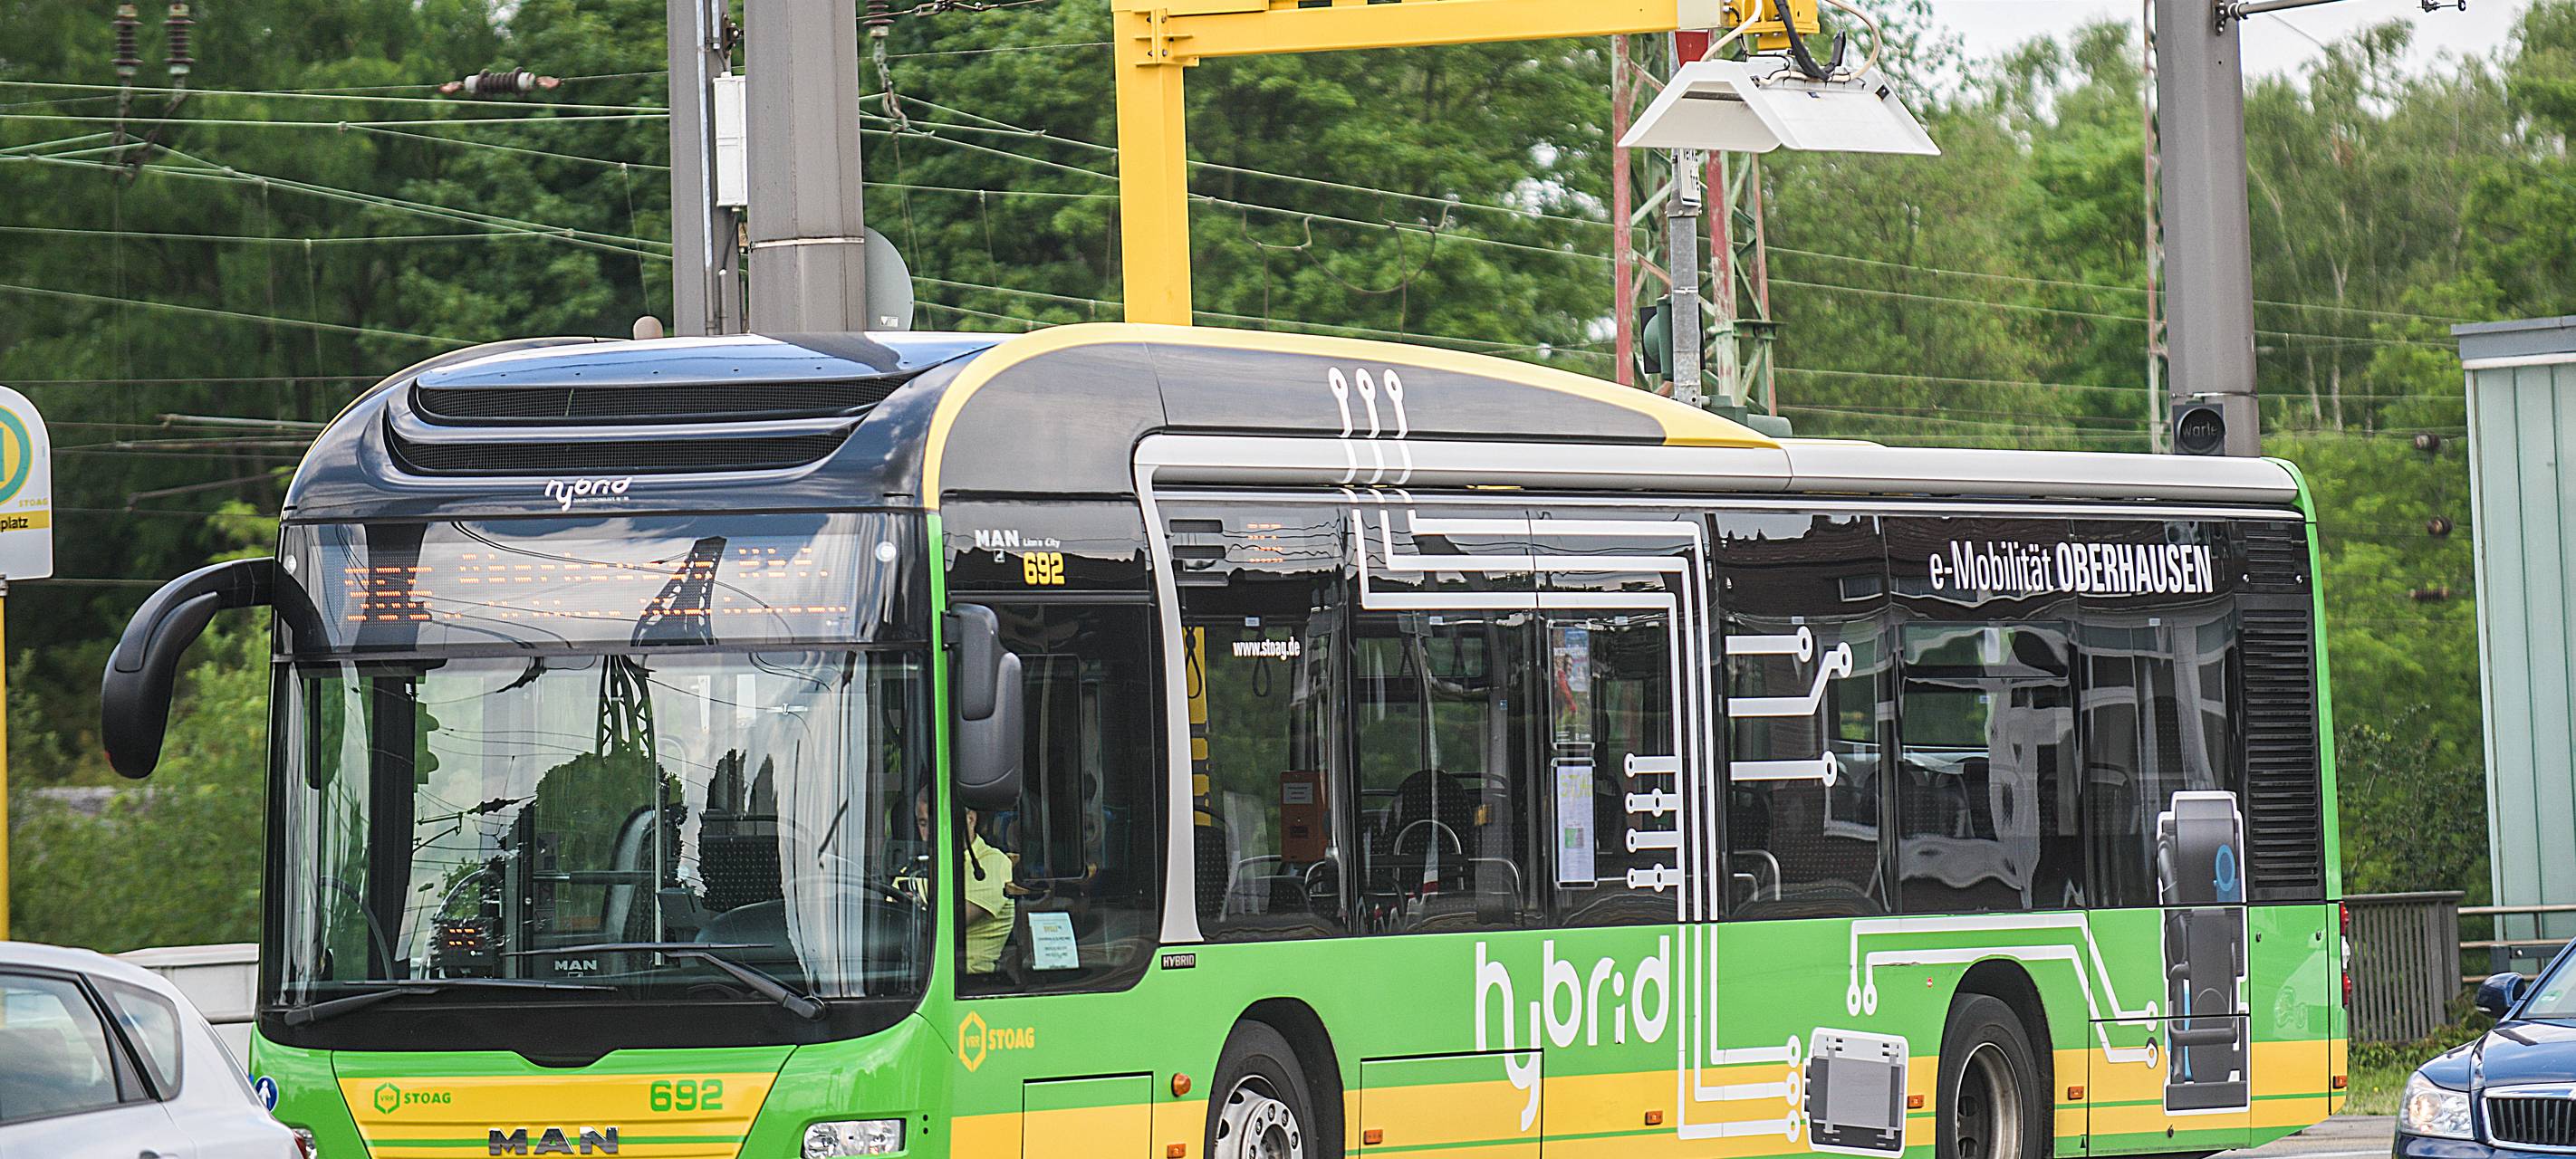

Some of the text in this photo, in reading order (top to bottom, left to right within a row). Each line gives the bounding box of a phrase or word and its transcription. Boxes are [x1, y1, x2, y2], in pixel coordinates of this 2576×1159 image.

[19, 497, 49, 507] STOAG
[544, 477, 633, 512] hybrid
[975, 530, 1019, 547] MAN
[1044, 537, 1061, 549] City
[1024, 551, 1065, 585] 692
[1929, 541, 2214, 593] e-Mobilität OBERHAUSEN
[1233, 637, 1301, 661] www.stoag.de
[554, 960, 597, 971] MAN
[1163, 954, 1195, 968] HYBRID
[989, 1027, 1034, 1050] STOAG
[1475, 934, 1670, 1132] hybrid
[404, 1092, 451, 1105] STOAG
[649, 1078, 724, 1112] 692
[488, 1125, 620, 1155] MAN
